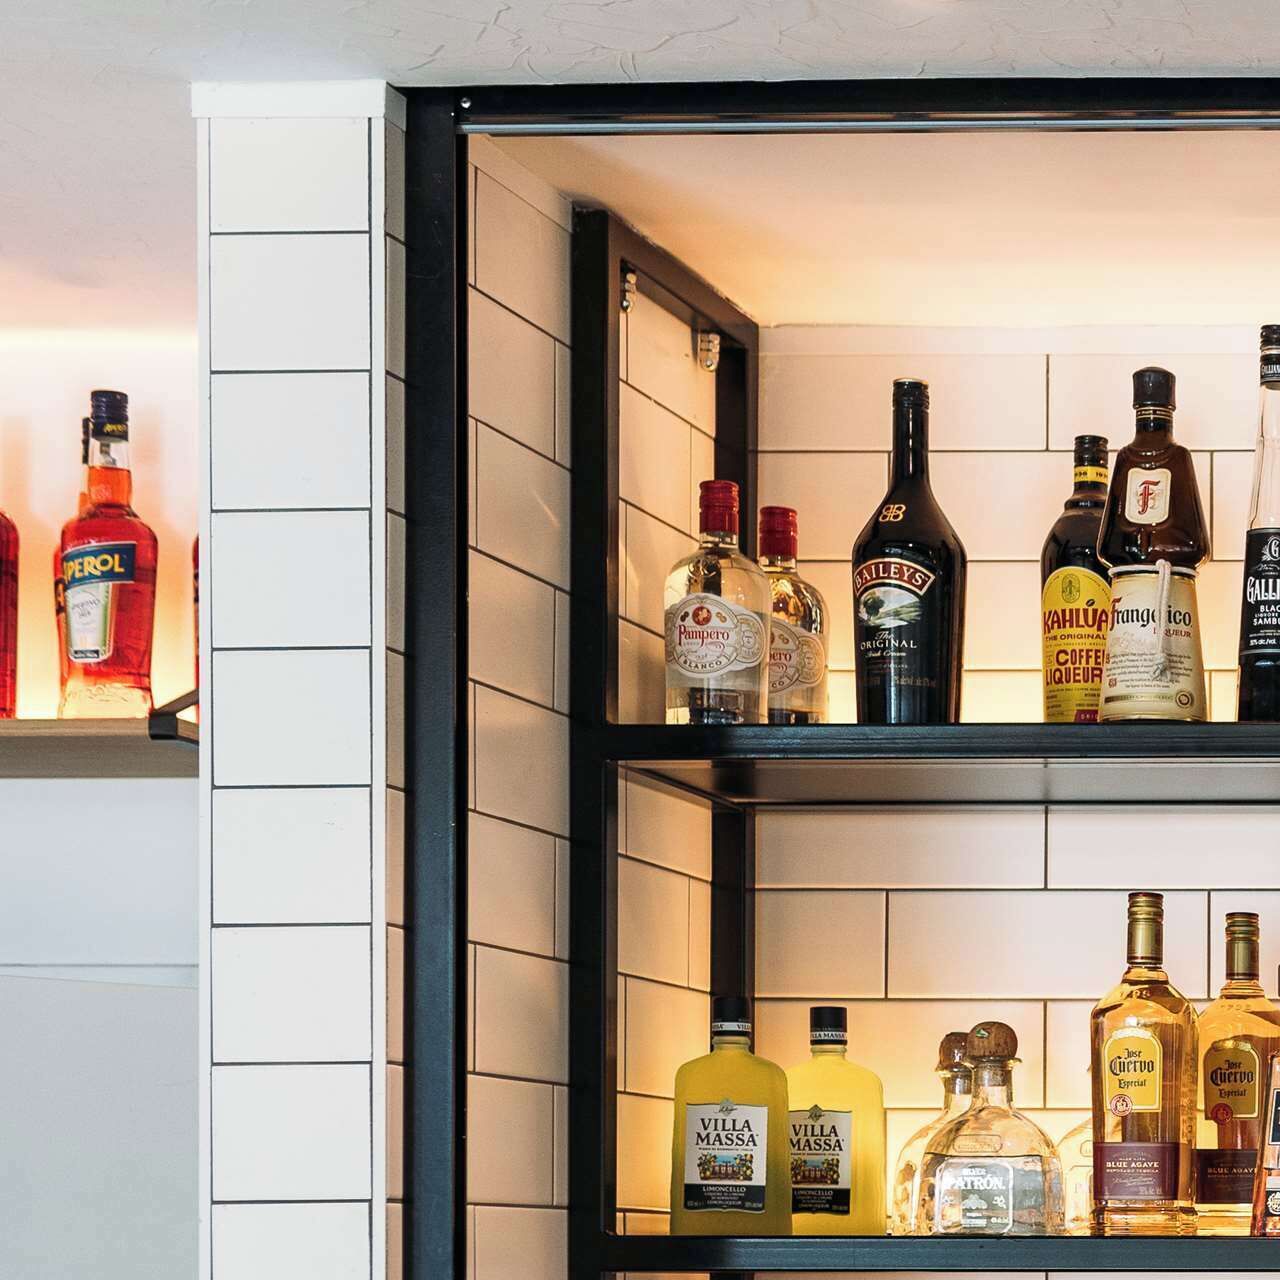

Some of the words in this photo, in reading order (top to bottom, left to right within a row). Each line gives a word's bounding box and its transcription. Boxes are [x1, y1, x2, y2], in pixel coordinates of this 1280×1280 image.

[854, 561, 927, 587] BAILEYS
[1044, 599, 1108, 635] KAHLÚA
[678, 624, 729, 646] Pampero
[860, 639, 917, 649] ORIGINAL
[1109, 1055, 1155, 1077] Cuervo
[1209, 1066, 1254, 1087] Cuervo
[700, 1117, 752, 1133] VILLA
[791, 1123, 839, 1138] VILLA
[694, 1131, 757, 1147] MASSA
[789, 1136, 842, 1151] MASSA
